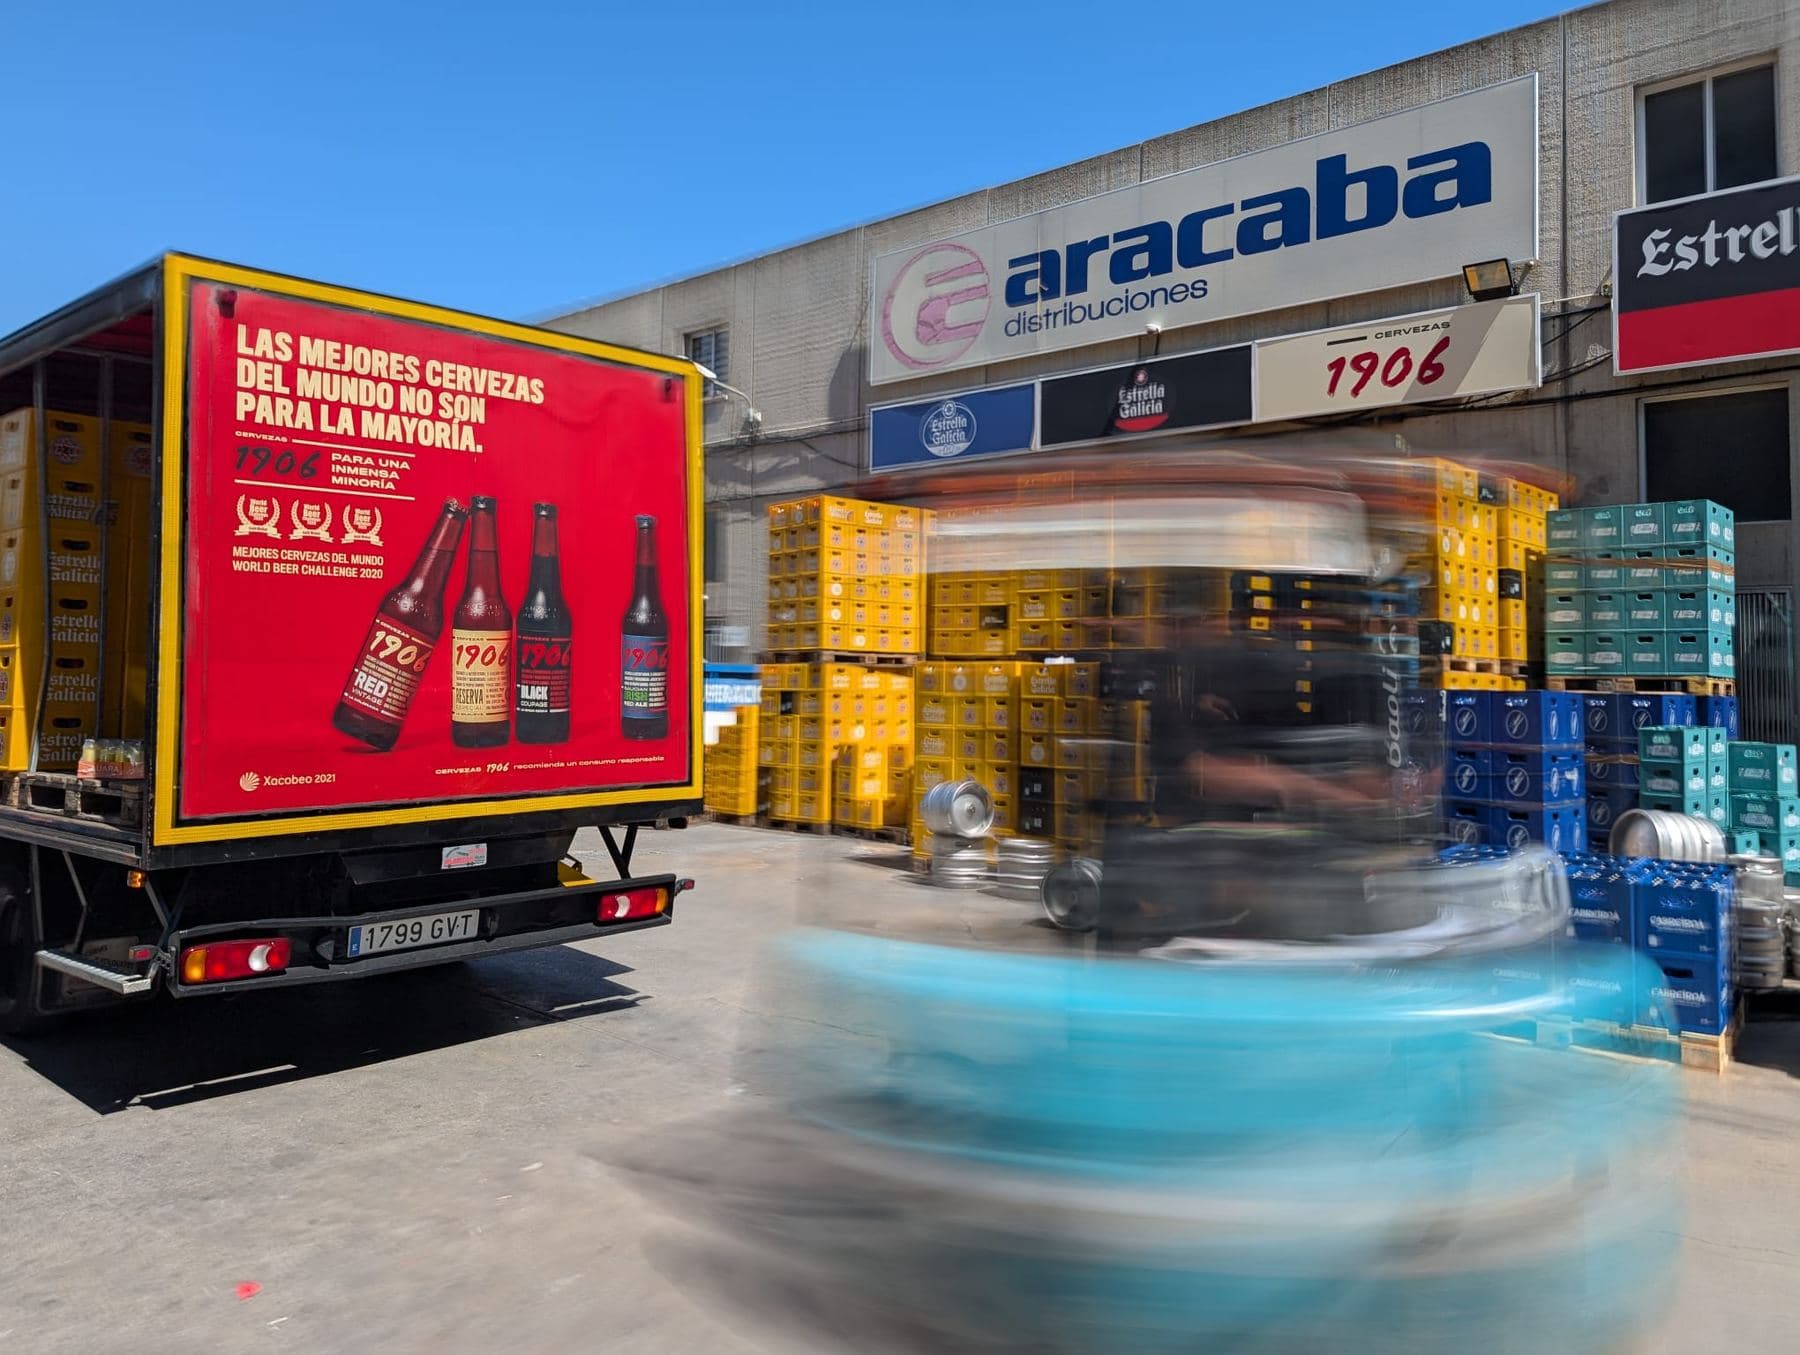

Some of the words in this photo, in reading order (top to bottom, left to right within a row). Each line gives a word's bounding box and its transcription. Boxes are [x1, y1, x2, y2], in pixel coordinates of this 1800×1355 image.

[1005, 141, 1492, 308] aracaba
[1004, 278, 1208, 338] distribuciones
[1374, 321, 1451, 340] CERVEZAS
[236, 323, 293, 362] LAS
[298, 335, 421, 384] MEJORES
[425, 360, 545, 405] CERVEZAS
[1327, 336, 1451, 398] 1906
[236, 357, 290, 396] DEL
[296, 368, 394, 410] MUNDO
[400, 386, 434, 416] NO
[438, 394, 486, 425] SON
[1118, 382, 1165, 404] Estrella
[1119, 399, 1163, 419] Galicia
[236, 391, 314, 431] PARA
[320, 405, 355, 437] LA
[361, 410, 483, 453] MAYORÍA.
[931, 416, 967, 432] Estrella
[235, 430, 288, 443] CERVEZAS
[932, 430, 965, 445] Galicia
[234, 444, 321, 479] 1906
[331, 453, 375, 466] PARA
[378, 458, 411, 470] UNA
[331, 464, 400, 480] INMENSA
[331, 475, 396, 490] MINORÍA
[232, 546, 279, 562] MEJORES
[281, 549, 331, 564] CERVEZAS
[331, 553, 349, 565] DEL
[351, 554, 384, 567] MUNDO
[232, 559, 270, 575] WORLD
[273, 562, 299, 576] BEER
[301, 564, 358, 578] CHALLENGE
[360, 566, 383, 579] 2020
[370, 631, 432, 672] 1906
[456, 644, 510, 669] 1906
[521, 642, 571, 668] 1906
[354, 671, 388, 699] RED
[520, 685, 548, 701] BLACK
[352, 687, 383, 705] VINTAGE
[456, 688, 483, 705] RESERVA
[435, 766, 482, 775] CERVEZAS
[486, 762, 510, 773] 1906
[513, 760, 565, 770] recomienda
[579, 757, 617, 766] consumo
[263, 773, 313, 787] Xacobeo
[314, 773, 336, 785] 2021
[367, 921, 423, 950] 1799
[431, 914, 473, 940] GVT
